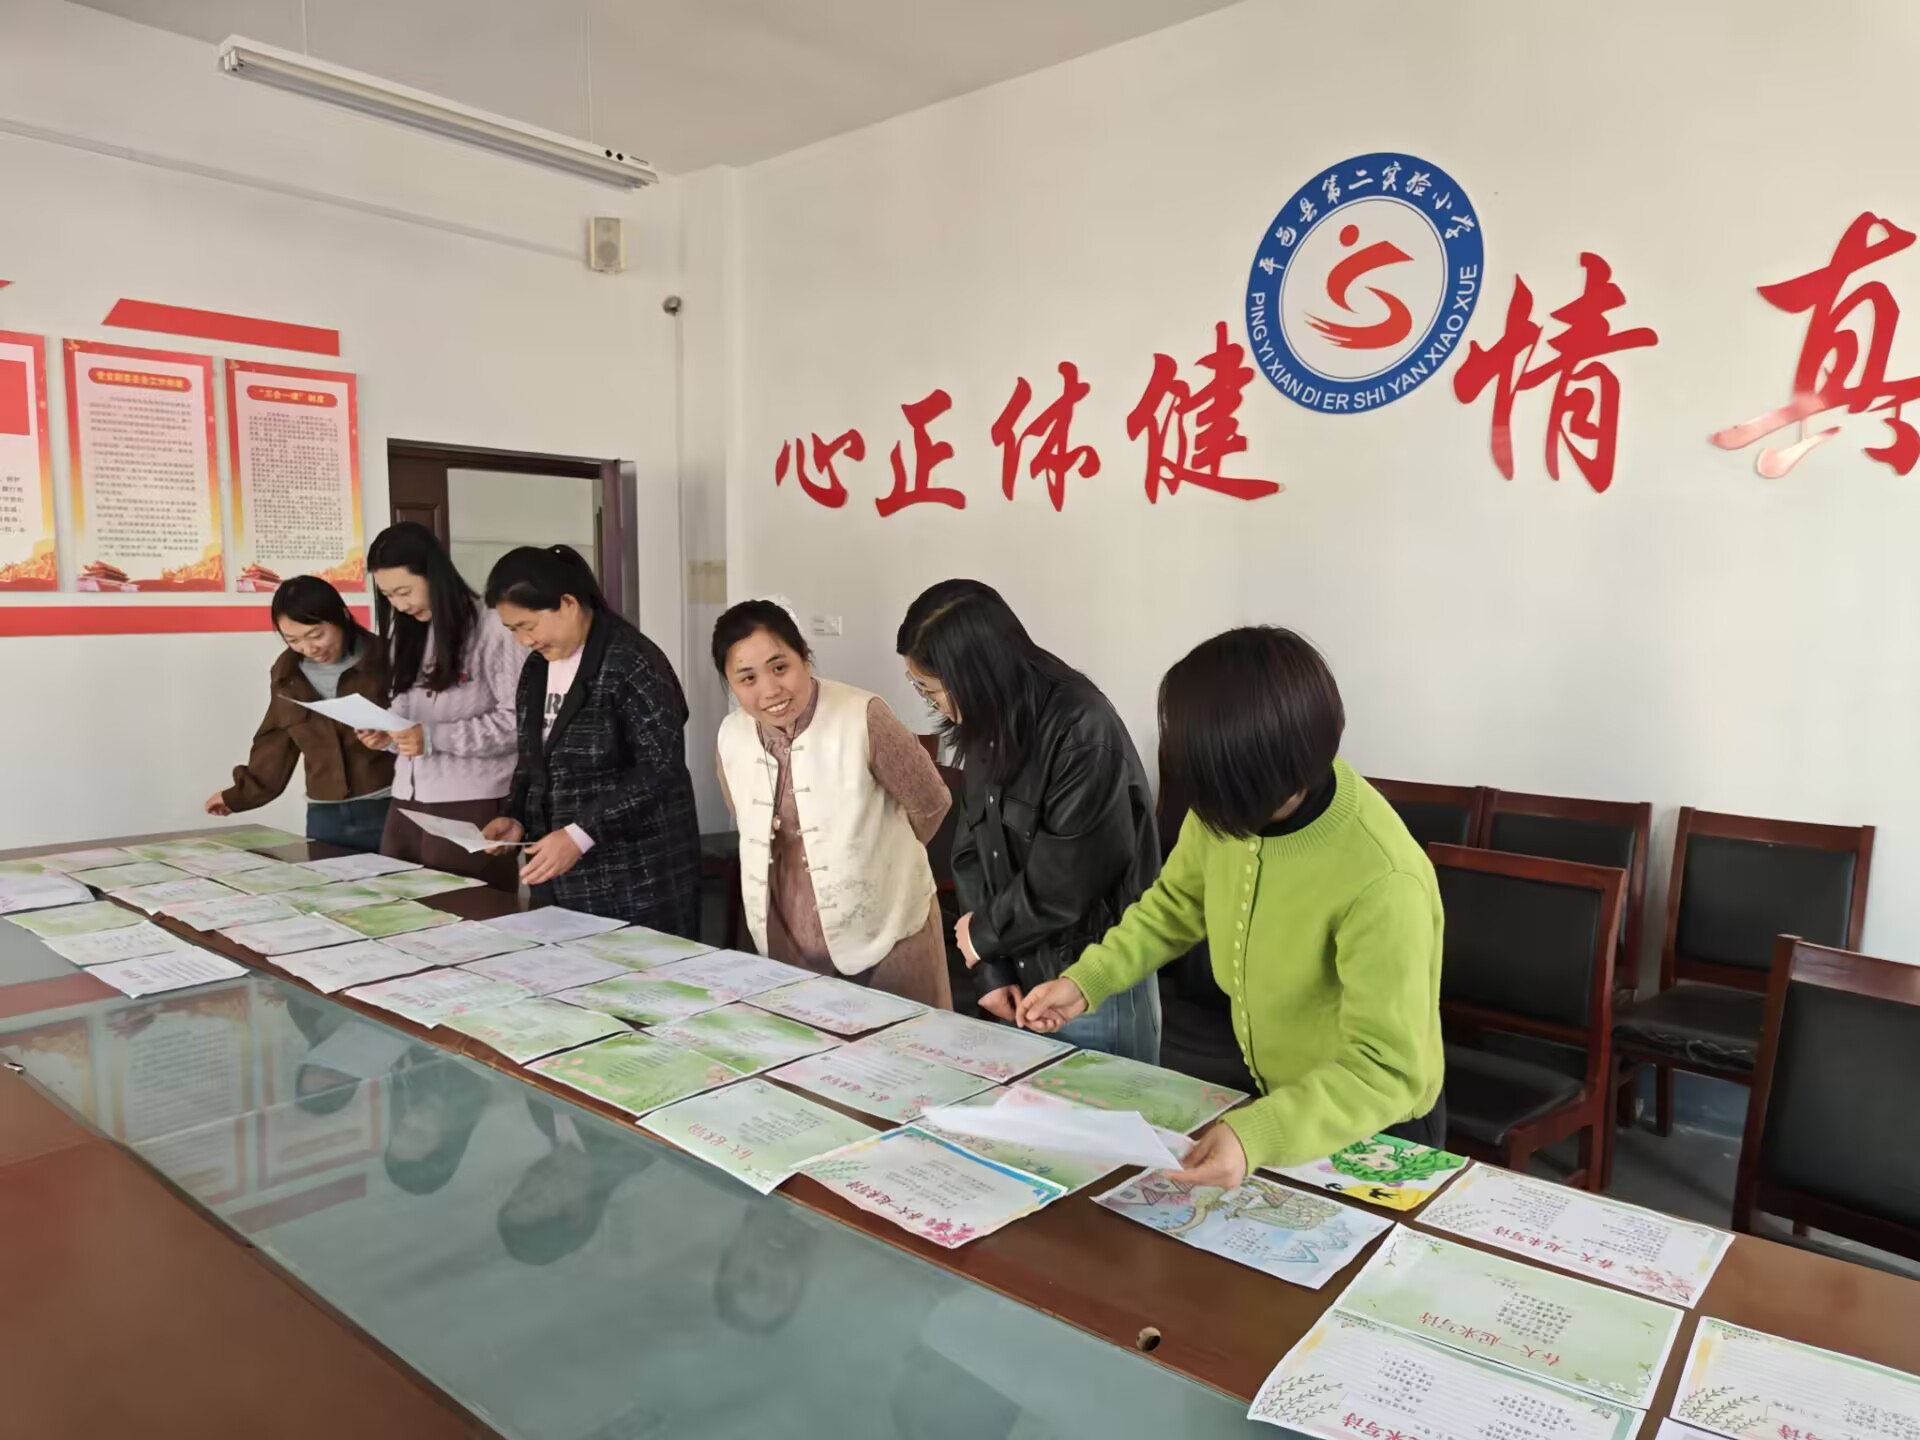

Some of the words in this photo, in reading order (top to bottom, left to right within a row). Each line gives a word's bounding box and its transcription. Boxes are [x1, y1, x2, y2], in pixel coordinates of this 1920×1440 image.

[1453, 263, 1478, 312] XUE
[1250, 291, 1268, 342] PING
[1257, 338, 1276, 361] YI
[1423, 313, 1464, 367] XIAO
[1265, 357, 1304, 397] XIAN
[1301, 385, 1320, 407] DI
[1387, 359, 1429, 395] YAN
[1322, 392, 1349, 410] ER
[1353, 385, 1387, 410] SHI
[775, 320, 1284, 518] 心正体健
